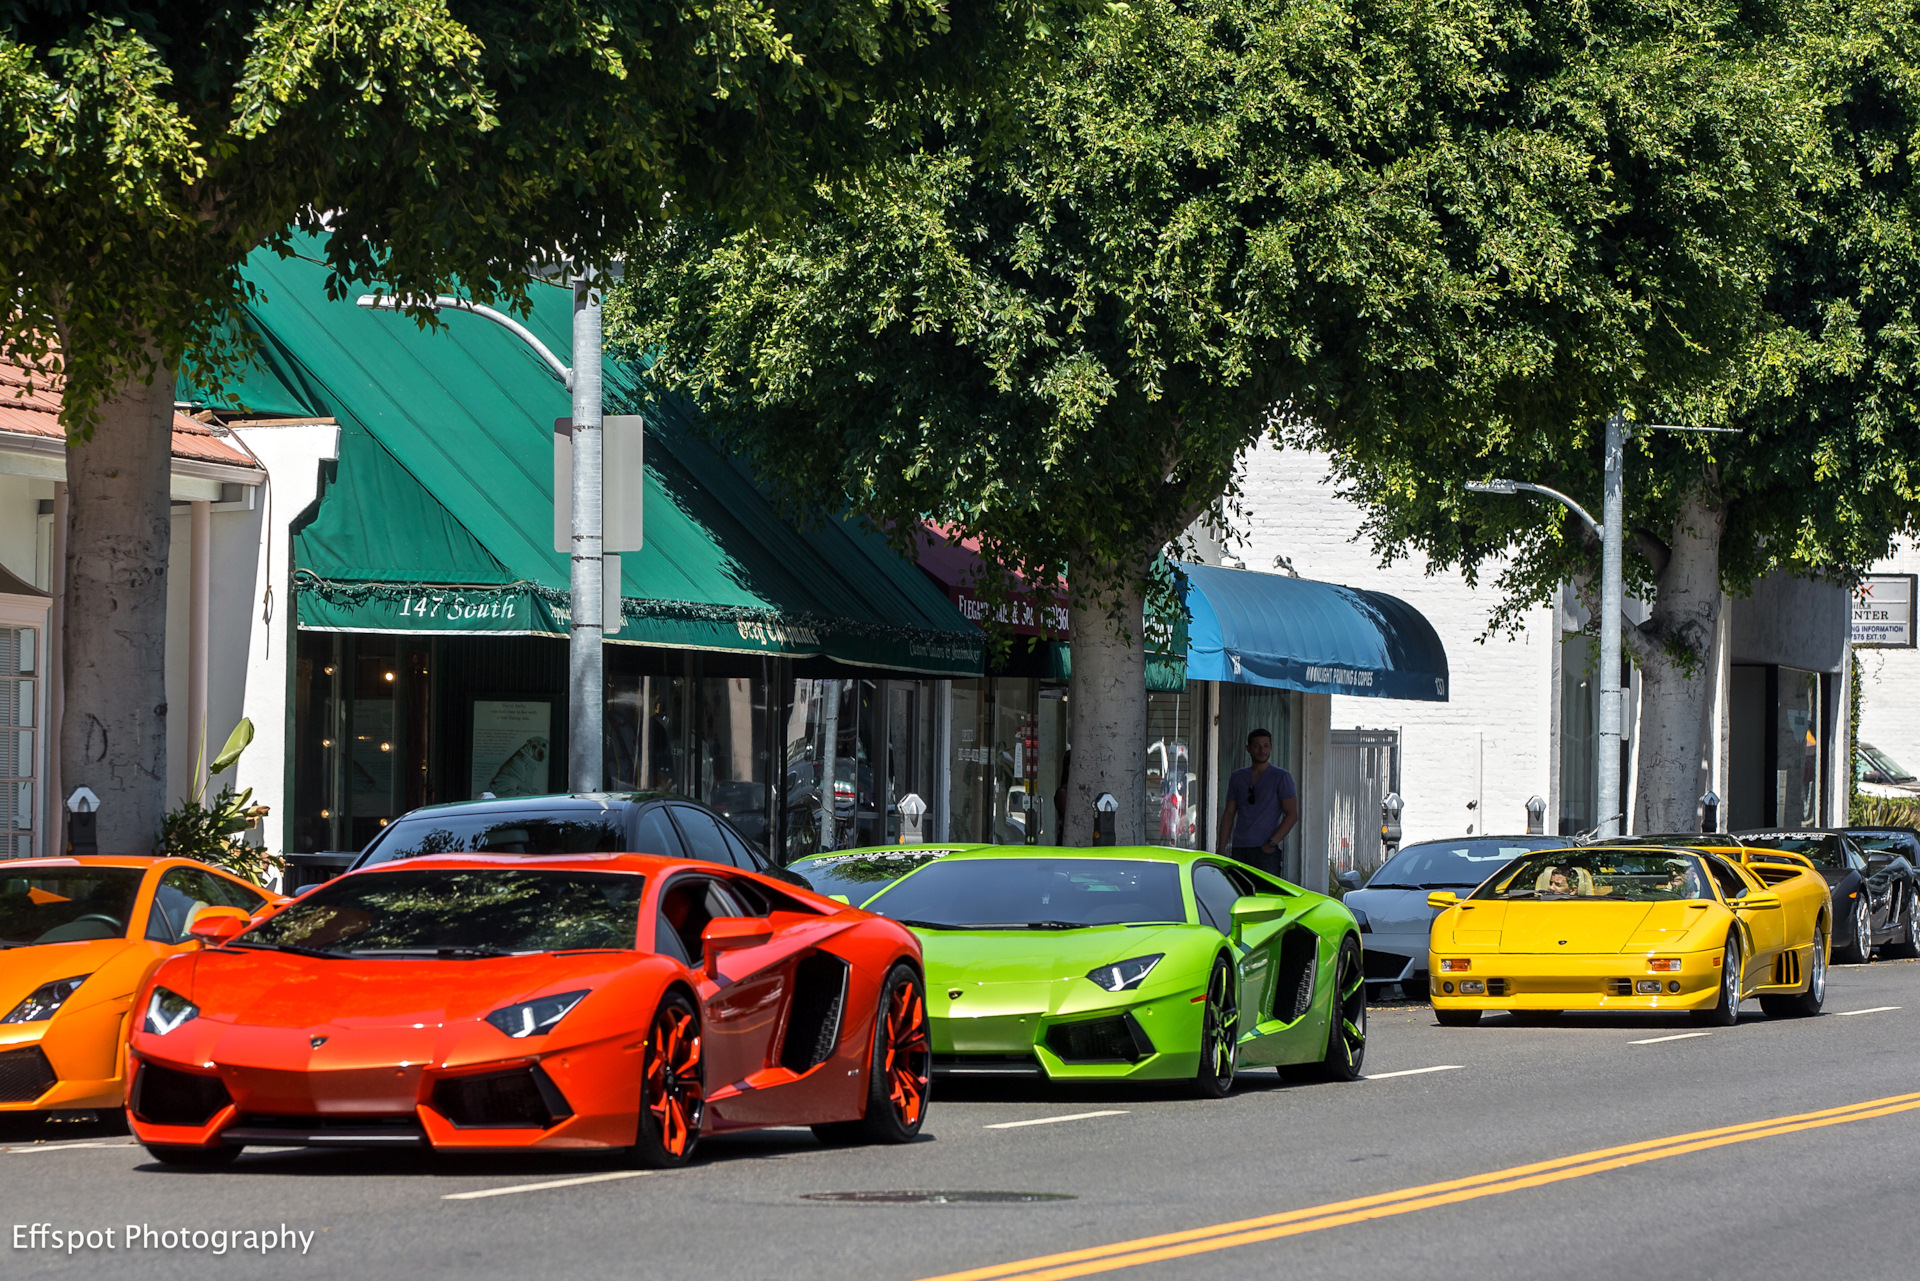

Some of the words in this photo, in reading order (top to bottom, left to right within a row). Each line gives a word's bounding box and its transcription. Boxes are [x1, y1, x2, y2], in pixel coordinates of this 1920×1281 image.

[399, 595, 444, 618] 147
[447, 594, 516, 620] South
[1853, 610, 1889, 620] NTER
[1861, 625, 1904, 633] INFORMATION
[1305, 665, 1333, 683] MOONLIGHT
[1333, 668, 1354, 686] PRINTING
[1353, 670, 1358, 686] &
[1358, 670, 1374, 687] COPIES
